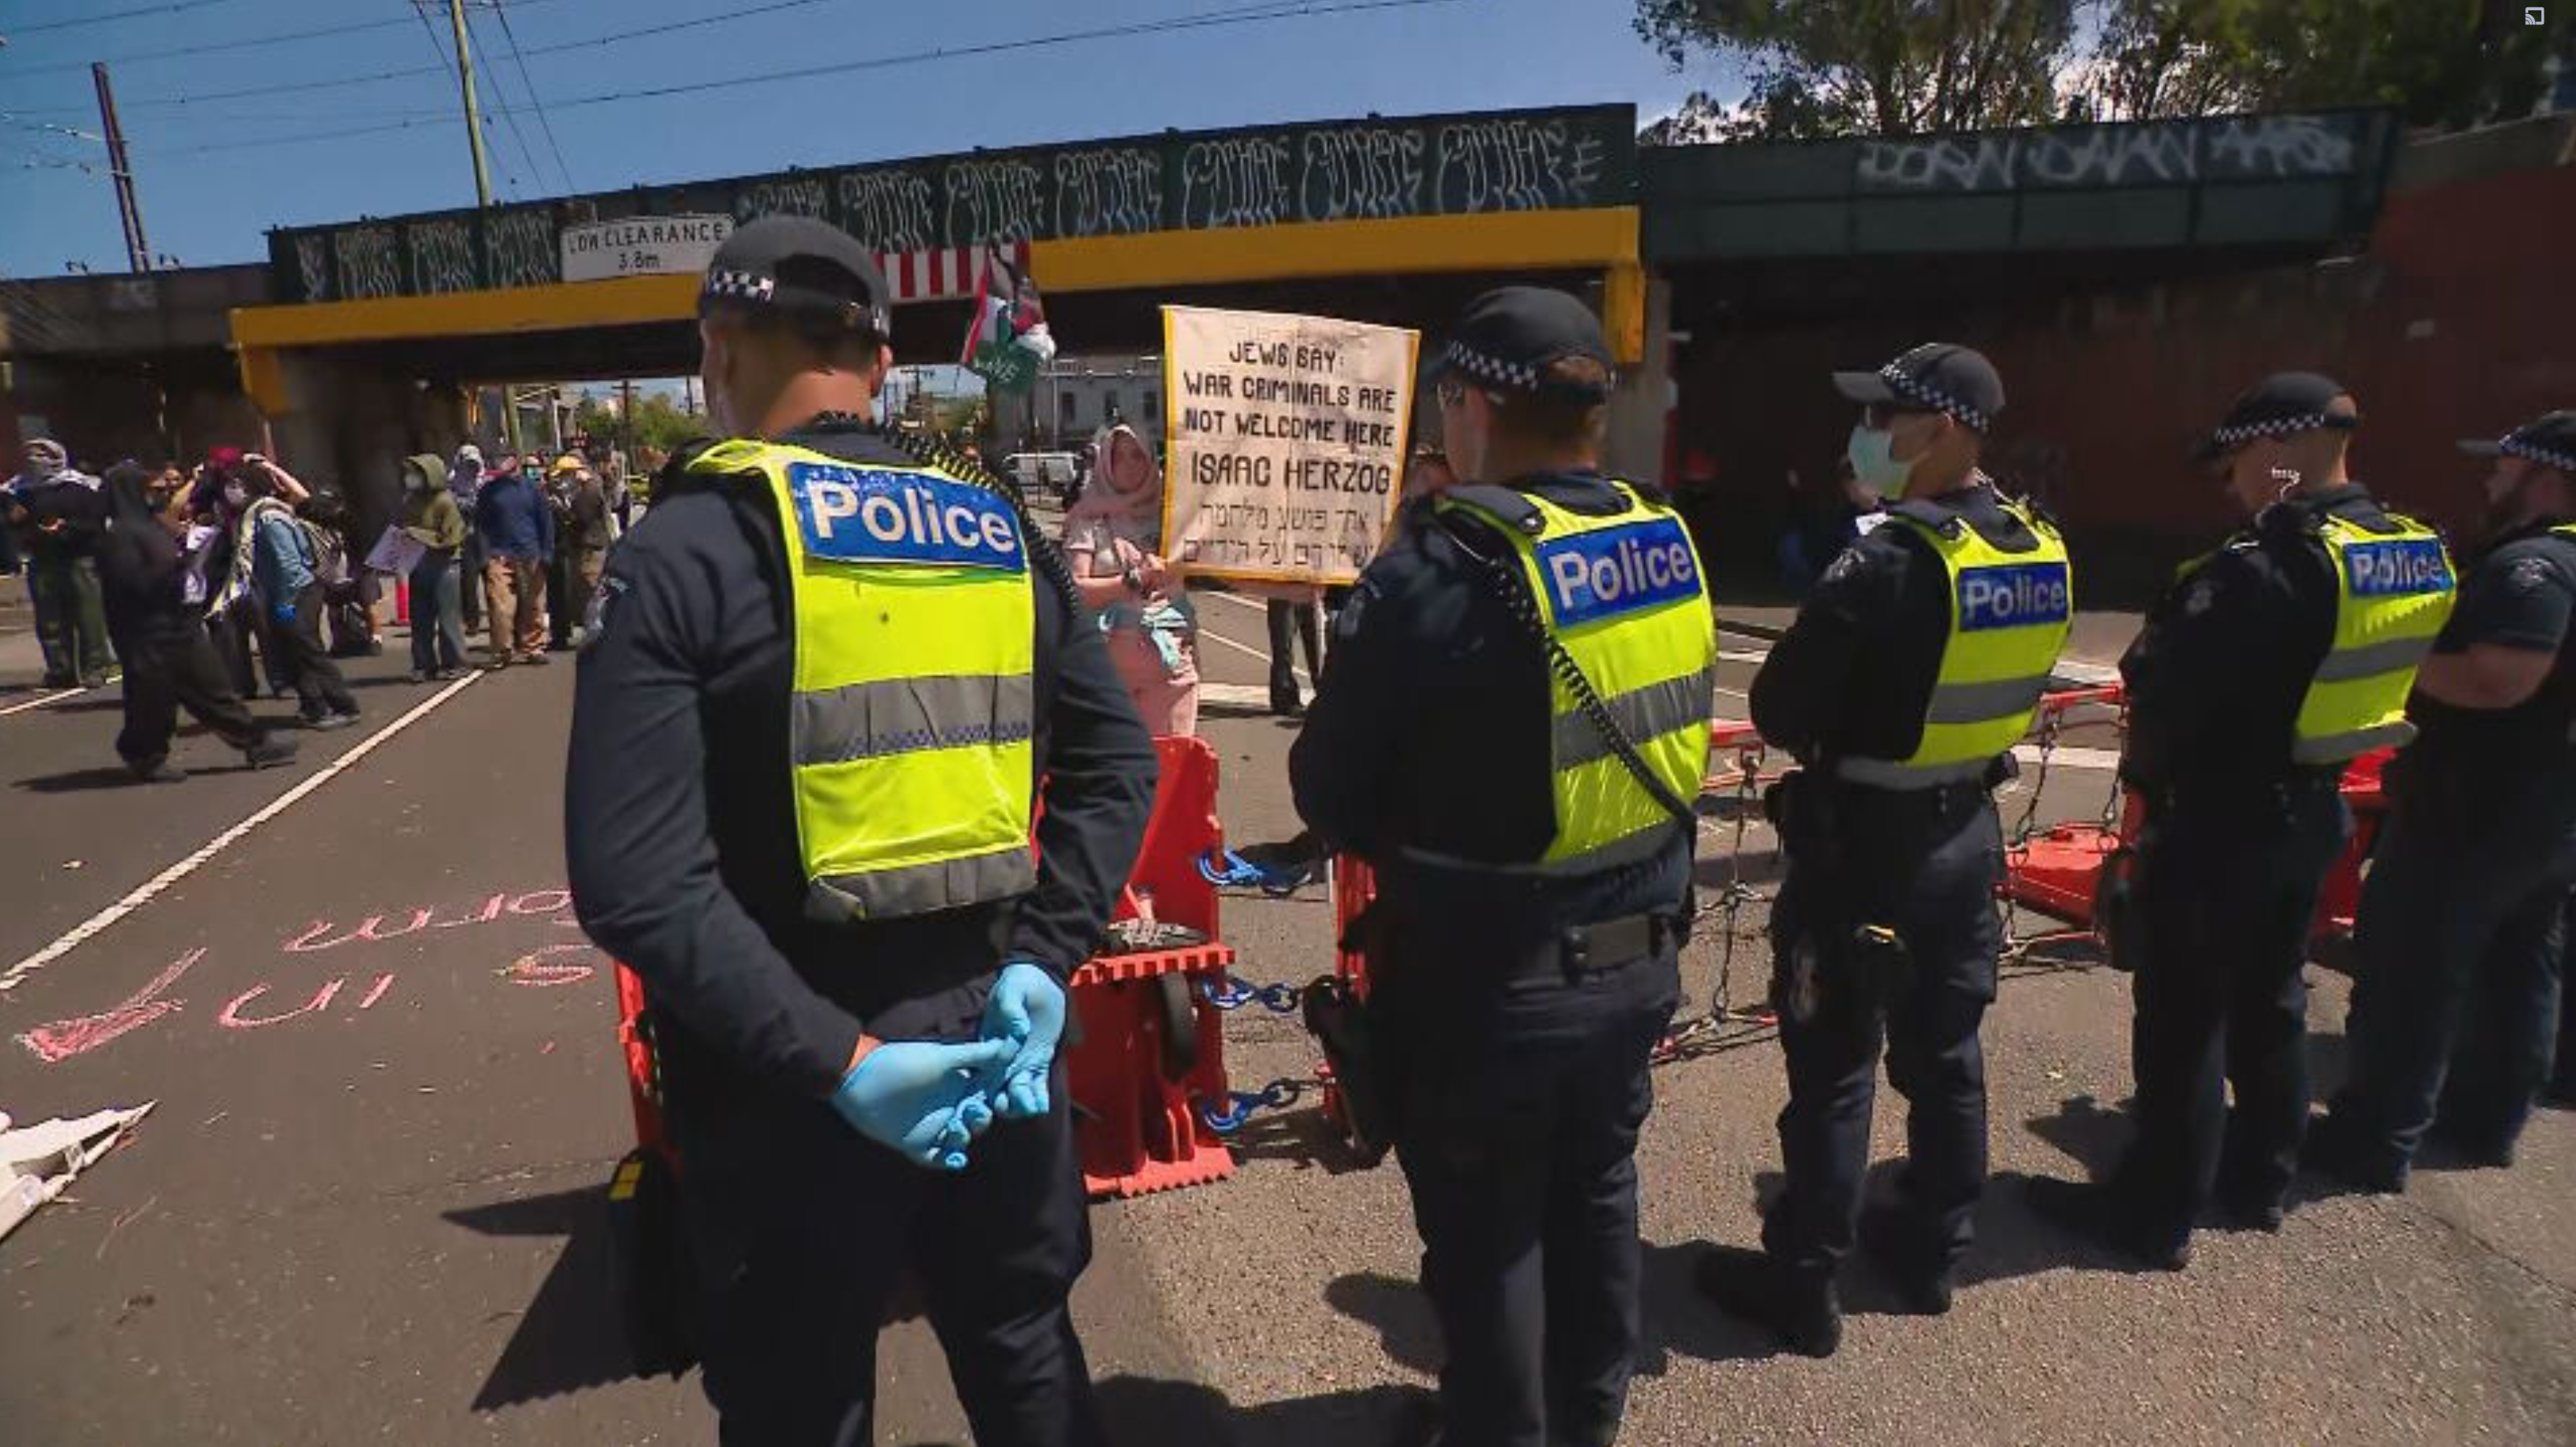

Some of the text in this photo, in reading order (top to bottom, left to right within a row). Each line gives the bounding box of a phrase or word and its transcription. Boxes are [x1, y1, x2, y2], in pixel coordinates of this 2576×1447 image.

[568, 223, 724, 254] LOW CLEARANCE
[1230, 342, 1290, 366] JEWS
[1184, 371, 1396, 412] WAR CRIMINALS ARE
[1185, 407, 1395, 447] NOT WELCOME HERE
[1192, 451, 1390, 495] ISAAC HERZOG
[806, 479, 1015, 553] Police
[1549, 536, 1691, 608] Police
[2353, 547, 2443, 590] Police
[1965, 574, 2065, 621] Police
